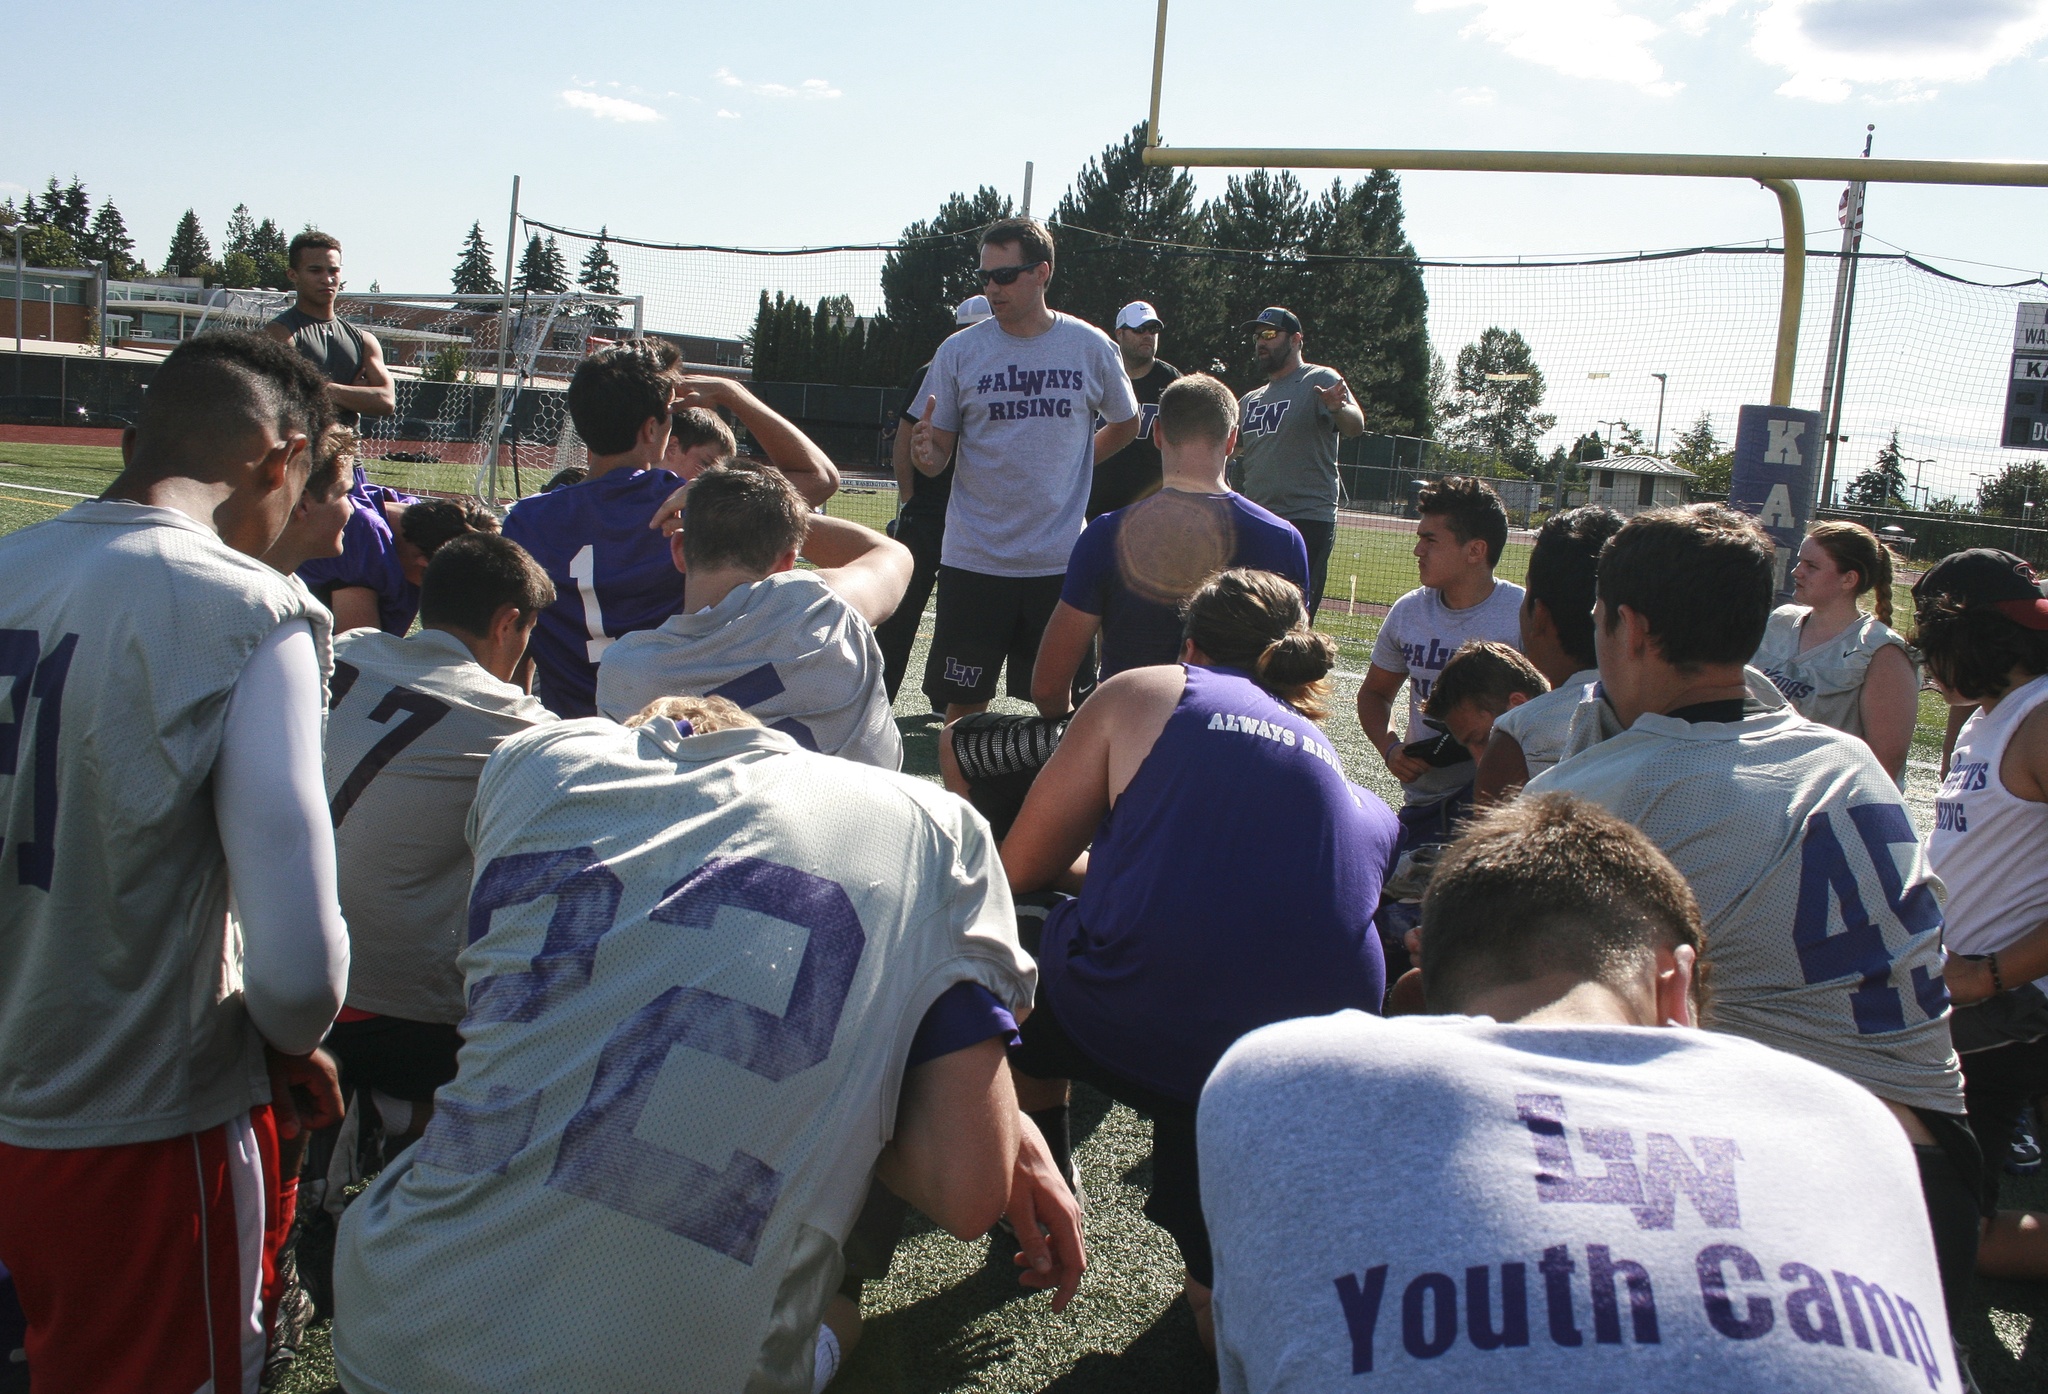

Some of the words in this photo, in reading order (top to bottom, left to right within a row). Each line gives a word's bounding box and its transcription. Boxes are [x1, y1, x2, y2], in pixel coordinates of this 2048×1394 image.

[2025, 328, 2048, 345] WA
[977, 365, 1083, 396] #ALWAYS
[989, 399, 1072, 420] RISING
[1243, 400, 1291, 437] LW
[569, 544, 616, 664] 1
[944, 656, 983, 688] LW
[1207, 712, 1296, 747] ALWAYS
[1792, 803, 1951, 1035] 45
[1514, 1093, 1745, 1231] LW
[1333, 1243, 1661, 1376] Youth
[1696, 1244, 1943, 1392] Camp
